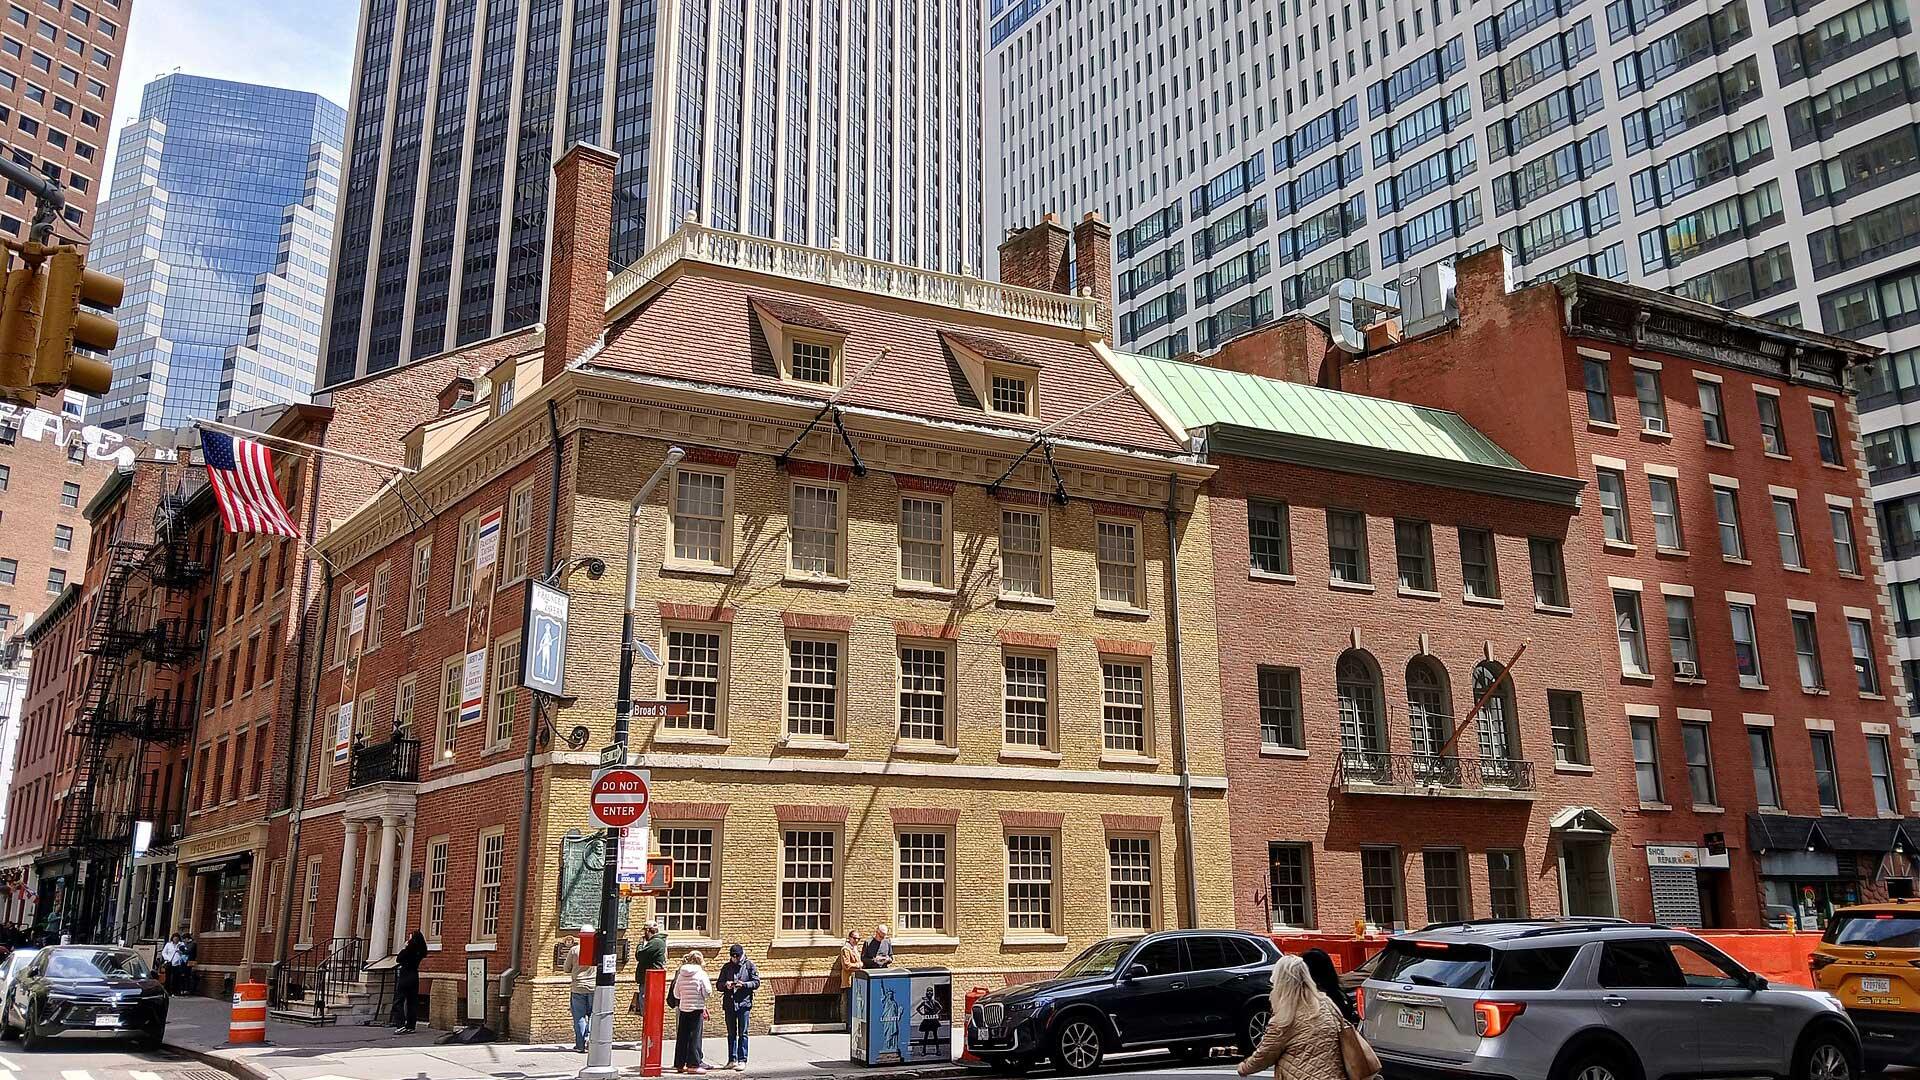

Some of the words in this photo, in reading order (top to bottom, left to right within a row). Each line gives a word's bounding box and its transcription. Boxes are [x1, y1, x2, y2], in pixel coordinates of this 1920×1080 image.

[634, 704, 656, 716] Broad
[659, 705, 667, 716] St
[602, 781, 616, 791] DO
[619, 781, 639, 791] NOT
[602, 806, 635, 816] ENTER
[621, 828, 628, 837] 3
[1648, 847, 1664, 855] SHOE
[1657, 856, 1678, 864] REPAIR
